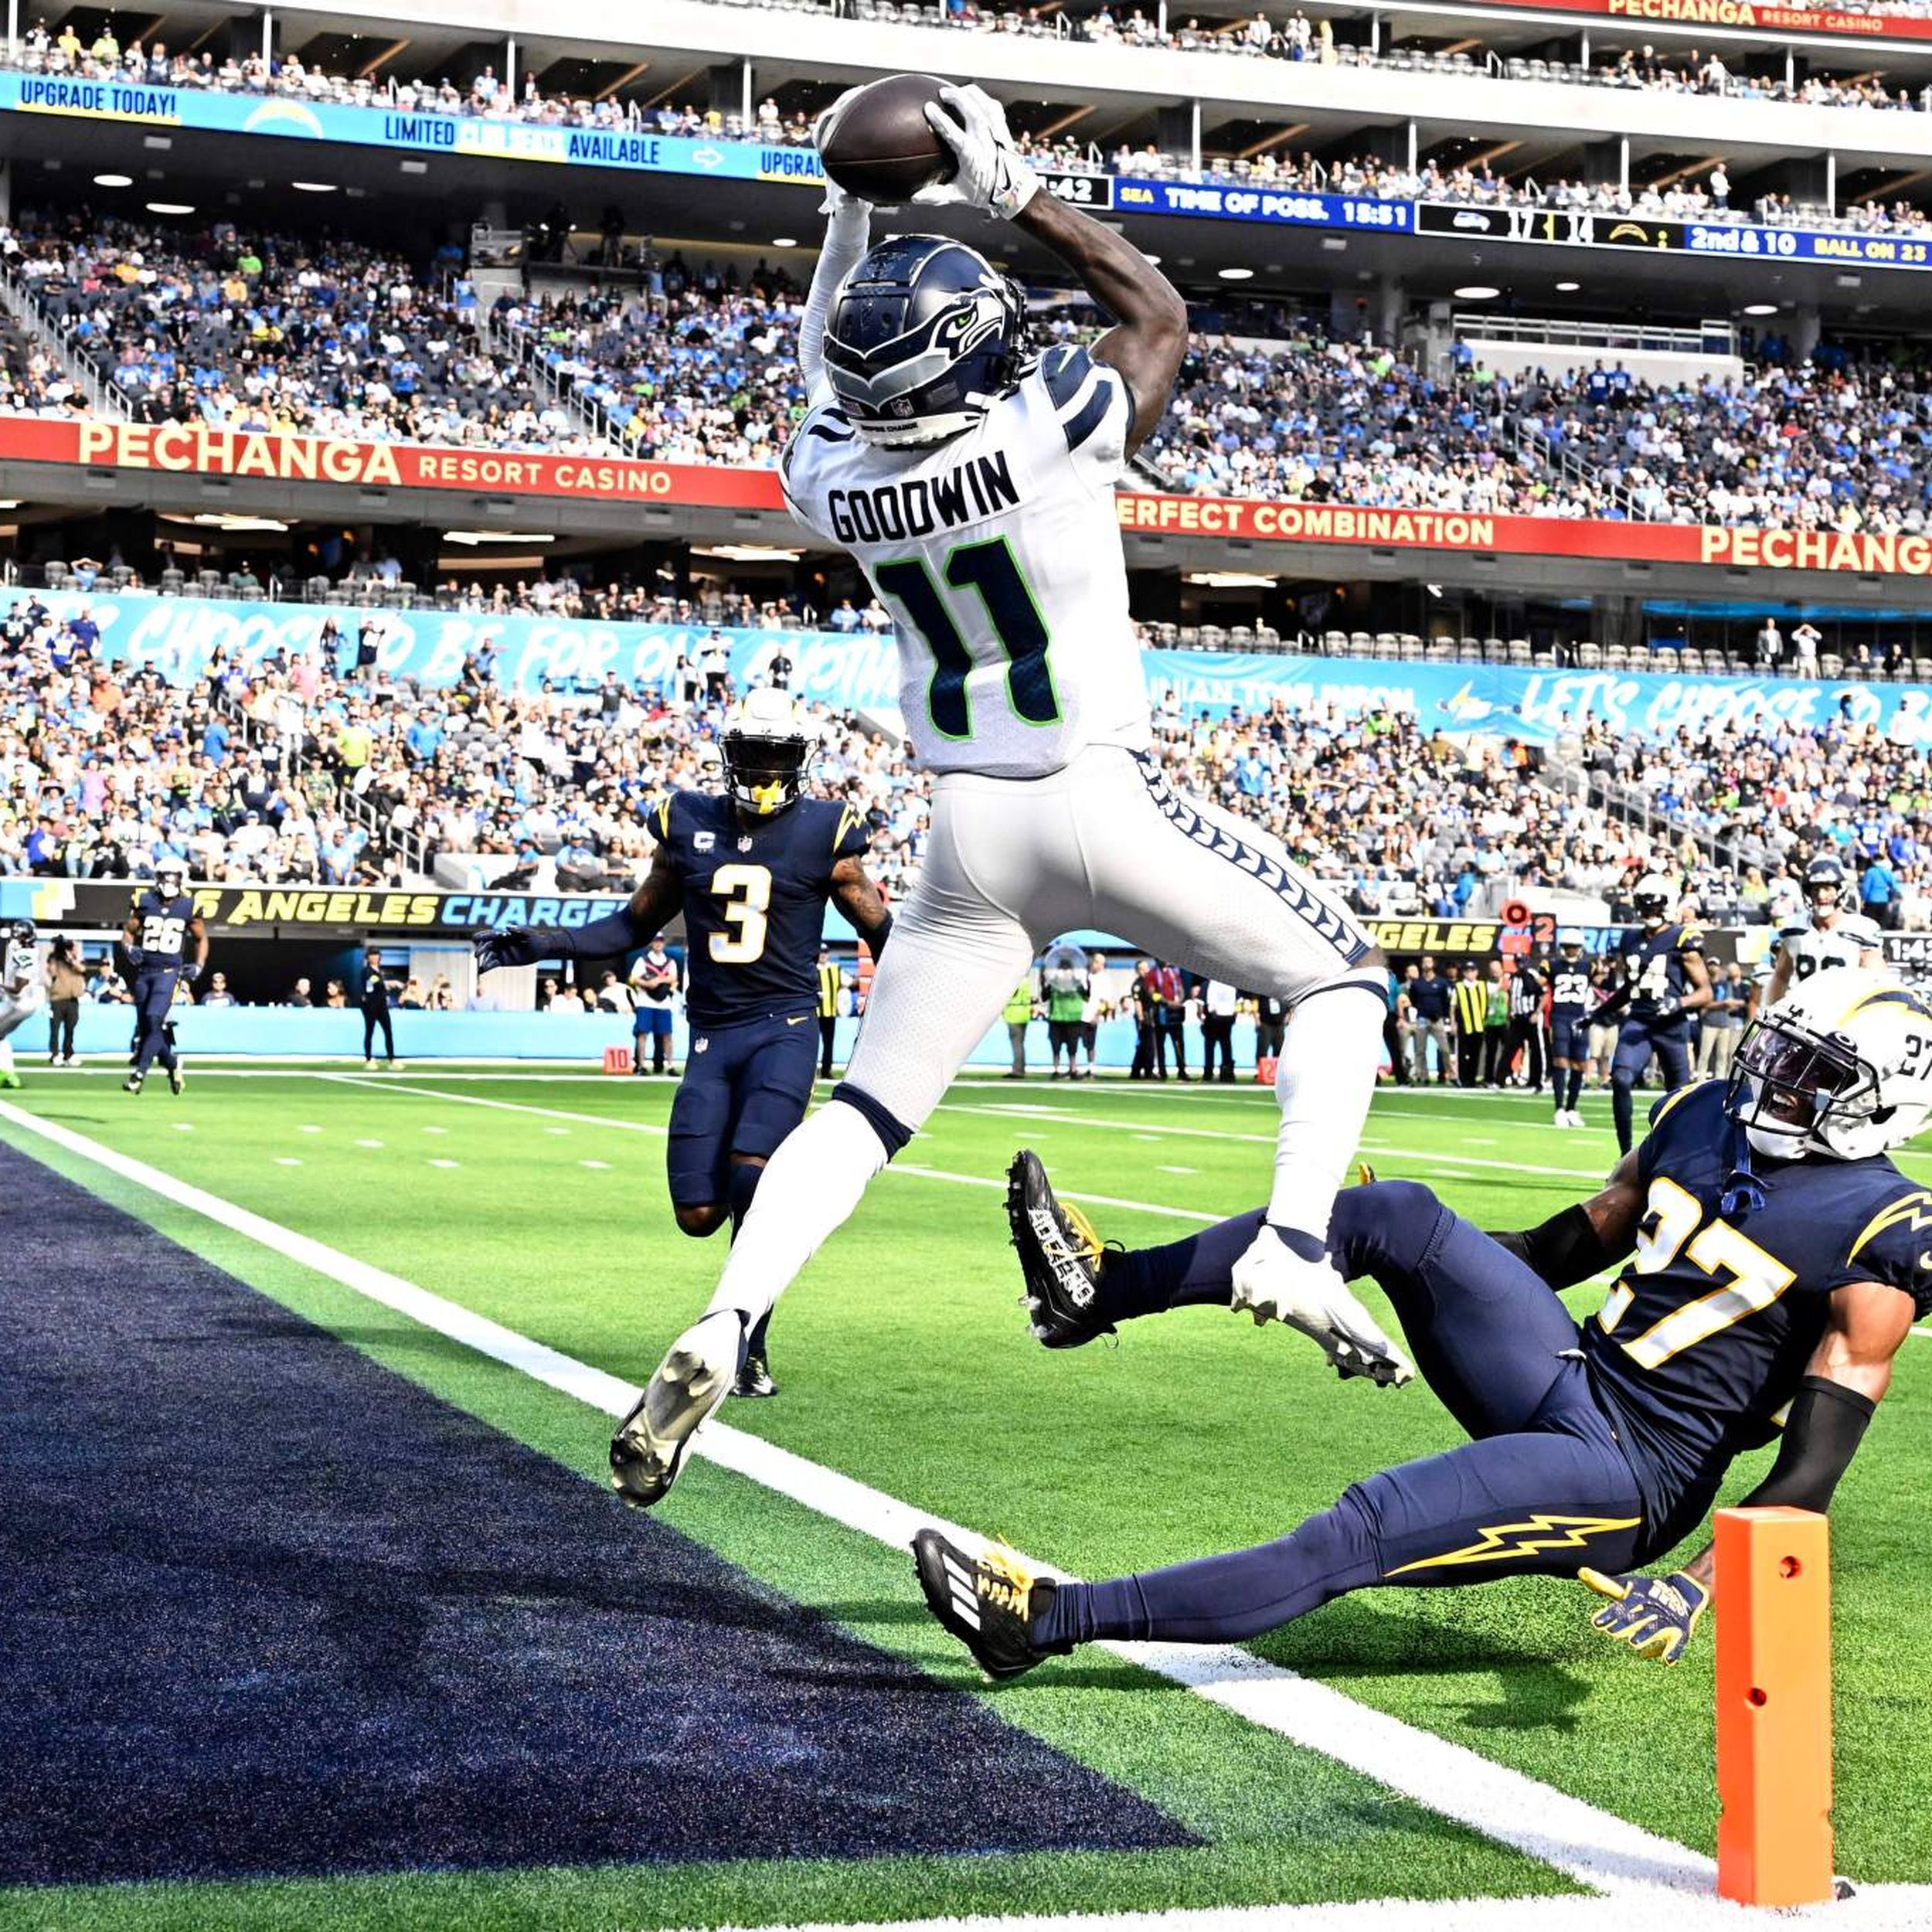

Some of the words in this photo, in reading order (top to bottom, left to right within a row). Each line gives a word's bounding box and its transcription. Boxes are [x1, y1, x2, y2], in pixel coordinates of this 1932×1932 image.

[1762, 10, 1821, 27] RESORT
[1825, 13, 1883, 32] CASINO
[21, 80, 104, 111] UPGRADE
[111, 89, 176, 117] TODAY!
[385, 117, 455, 146] LIMITED
[568, 134, 661, 165] AVAILABLE
[1120, 187, 1155, 204] SEA
[1165, 188, 1222, 212] TIME
[1225, 191, 1260, 215] OF
[1262, 194, 1330, 222] POSS.
[1507, 210, 1535, 241] 17
[1690, 226, 1740, 252] 2nd
[1740, 230, 1760, 253] &
[1764, 232, 1798, 256] 10
[1814, 237, 1863, 259] BALL
[1865, 241, 1896, 260] ON
[79, 423, 402, 485] PECHANGA
[419, 454, 543, 485] RESORT
[554, 464, 671, 495] CASINO
[828, 451, 1020, 543] GOODWIN
[1253, 506, 1495, 545] COMBINATION
[1701, 525, 1932, 574] PECHANG
[874, 534, 1063, 741] 11
[226, 890, 439, 925] ANGELES
[708, 862, 773, 964] 3
[142, 915, 185, 955] 26
[1535, 917, 1554, 942] 2
[1553, 973, 1589, 1004] 23
[610, 1049, 628, 1069] 10
[1597, 1175, 1799, 1371] 27
